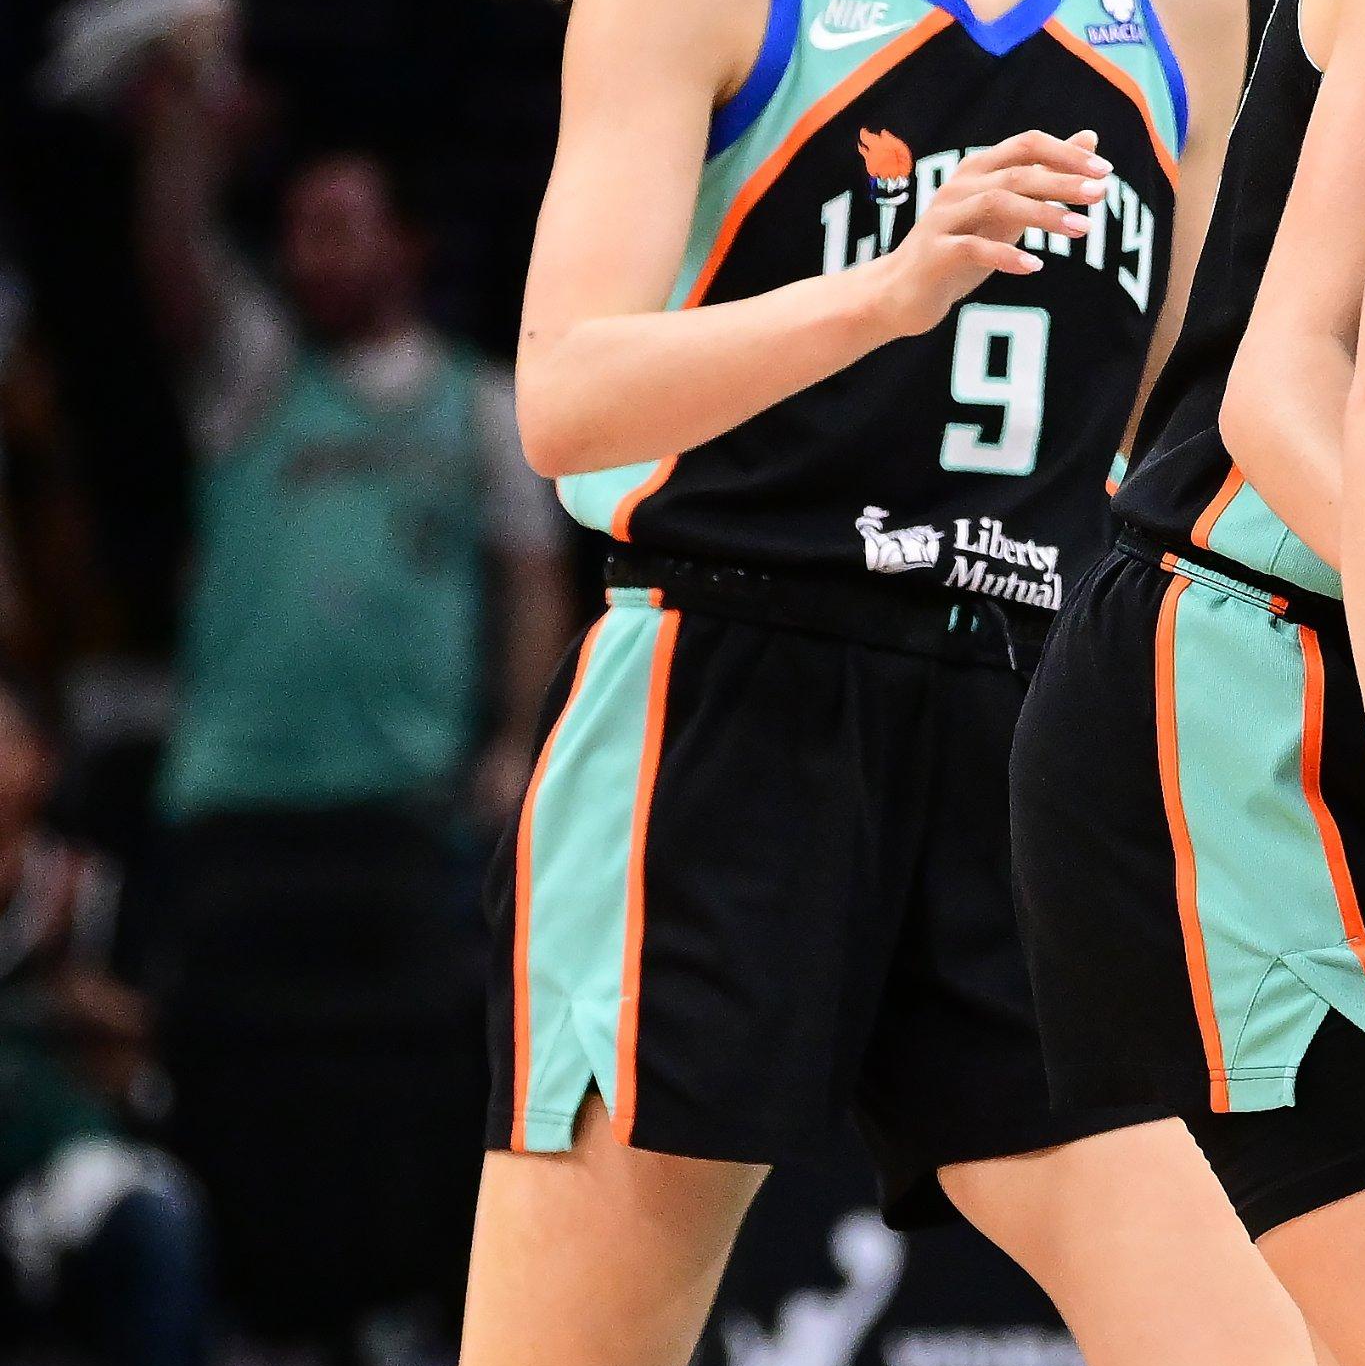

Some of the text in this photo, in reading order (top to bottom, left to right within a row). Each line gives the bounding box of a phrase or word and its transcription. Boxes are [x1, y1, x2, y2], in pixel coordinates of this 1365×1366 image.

[939, 302, 1051, 477] 9
[953, 516, 1059, 573] Liberty
[943, 555, 1063, 611] Mutual
